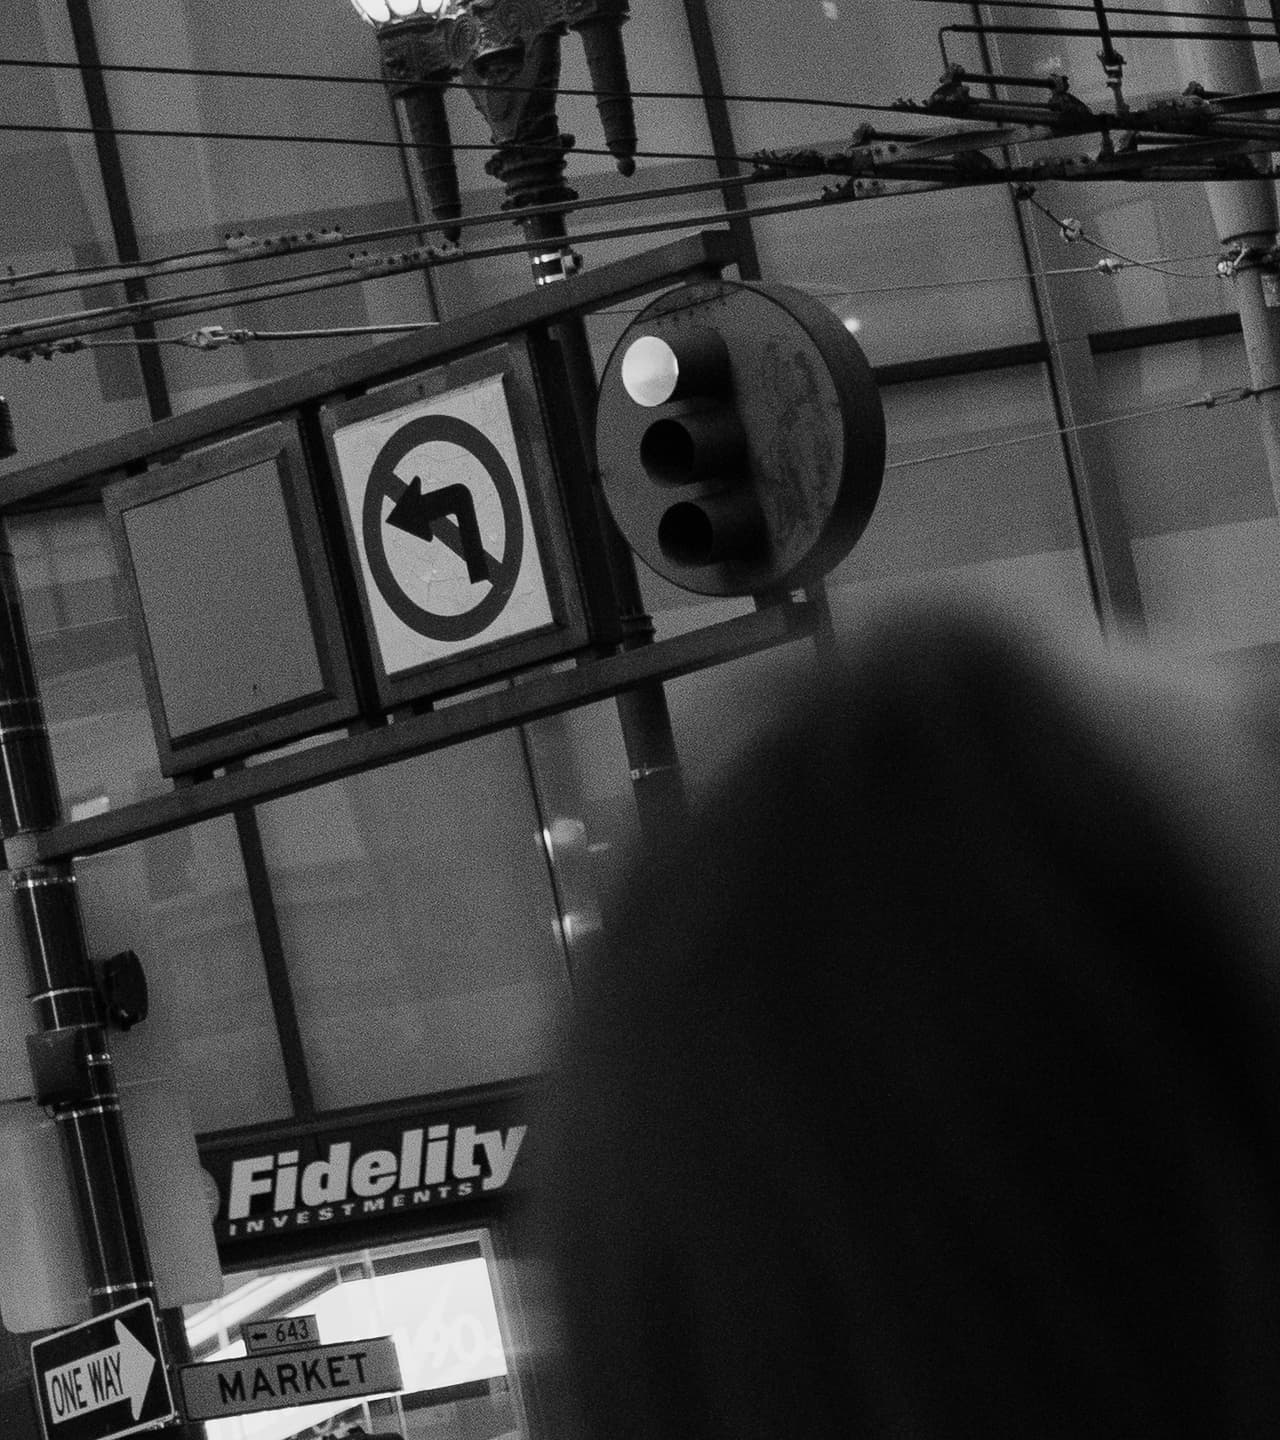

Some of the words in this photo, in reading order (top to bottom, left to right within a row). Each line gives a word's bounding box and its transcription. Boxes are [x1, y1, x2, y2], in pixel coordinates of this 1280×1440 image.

[229, 1124, 527, 1220] Fidelity
[229, 1182, 473, 1236] INVESTMENTS
[275, 1319, 309, 1343] 643
[50, 1368, 88, 1417] ONE
[87, 1352, 124, 1405] WAY
[217, 1352, 368, 1404] MARKET
